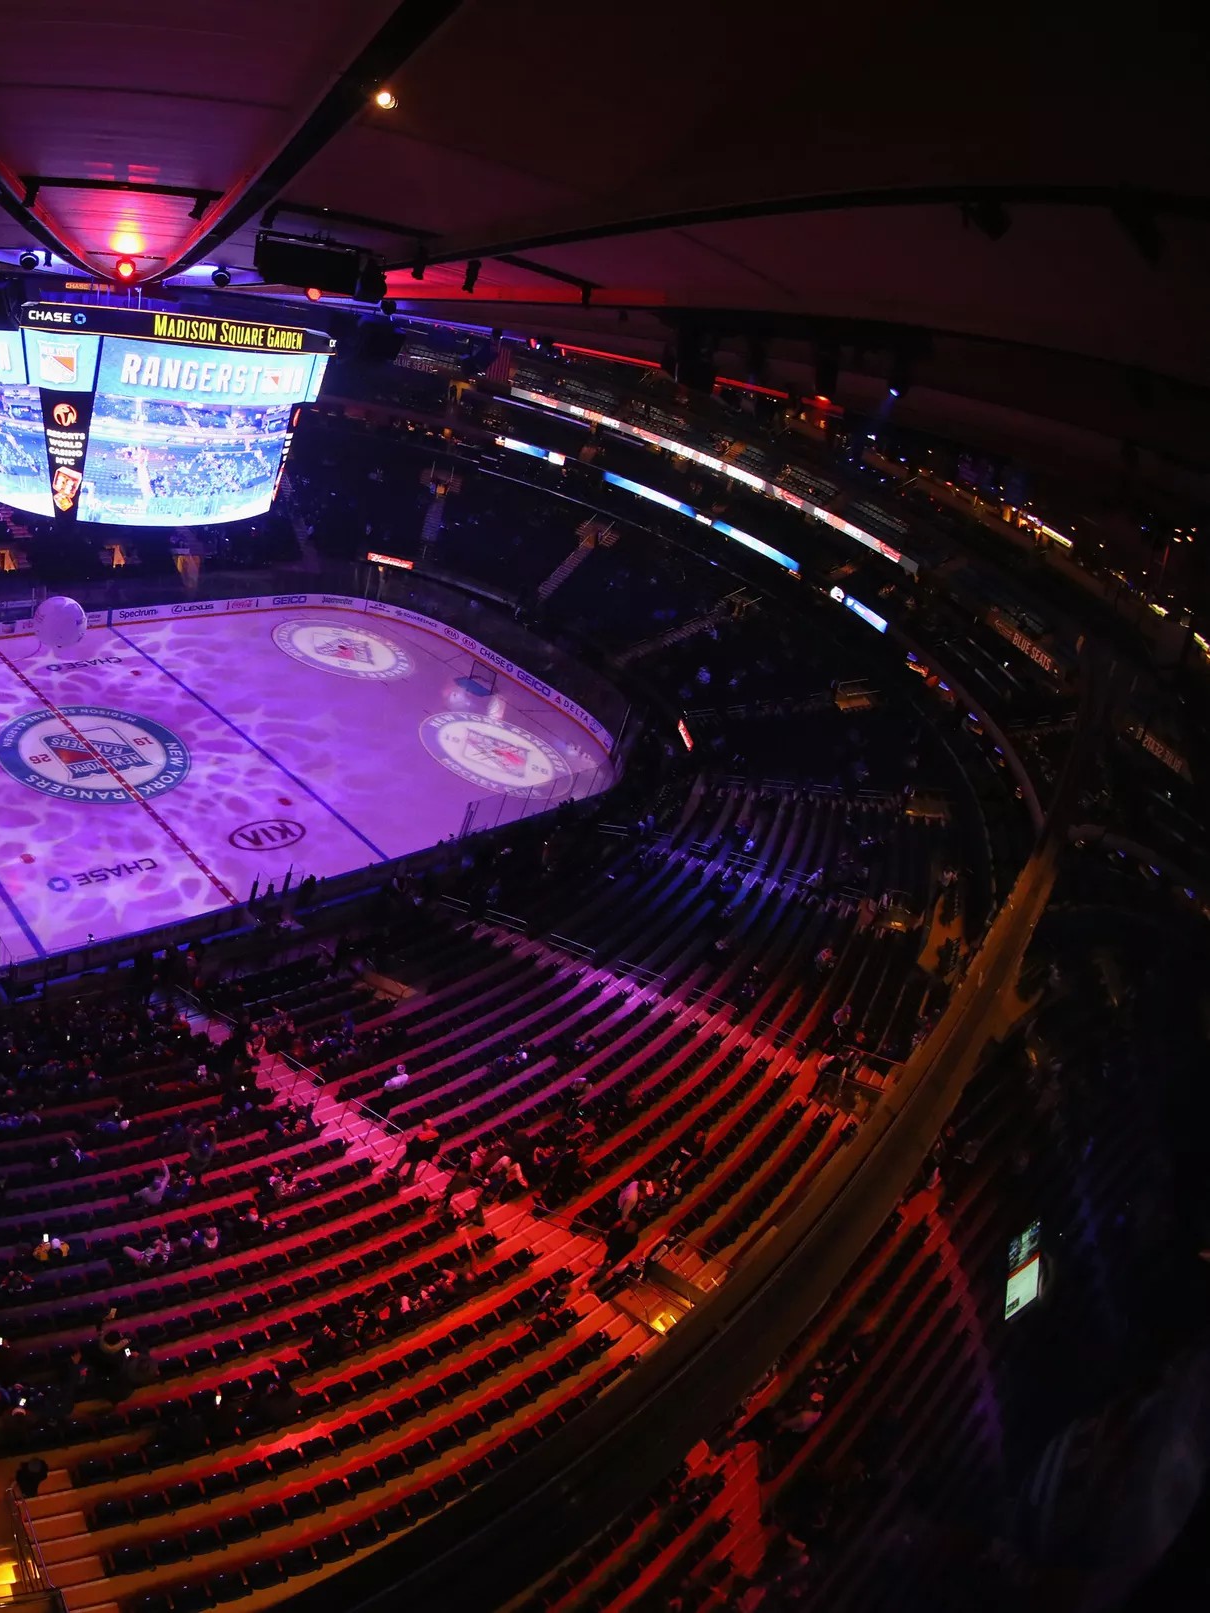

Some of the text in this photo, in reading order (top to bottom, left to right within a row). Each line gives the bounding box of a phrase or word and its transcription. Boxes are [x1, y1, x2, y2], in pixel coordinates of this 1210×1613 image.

[28, 310, 72, 323] CHASE
[153, 314, 303, 350] MADISON SQUARE GARDEN
[412, 361, 434, 374] SEATS
[46, 428, 86, 440] RESORTS
[48, 438, 83, 448] WORLD
[48, 447, 83, 457] CASINO
[55, 457, 75, 466] NYC
[272, 595, 308, 606] GEICO
[183, 603, 215, 612] LEXUS
[119, 609, 158, 621] Spectrum
[403, 612, 438, 629] SQUARESPACE
[446, 628, 458, 638] KIA
[464, 638, 476, 648] KIA
[479, 648, 506, 668] CHASE
[1012, 632, 1053, 671] BLUE SEATS
[64, 656, 123, 670] CHASE
[516, 670, 551, 698] GEICO
[563, 700, 590, 722] DELTA
[430, 713, 456, 728] NEW
[133, 736, 155, 747] 19
[29, 753, 52, 764] 26
[25, 741, 184, 800] NEW YORK RANGERS
[238, 824, 298, 847] KIA
[73, 857, 159, 886] CHASE
